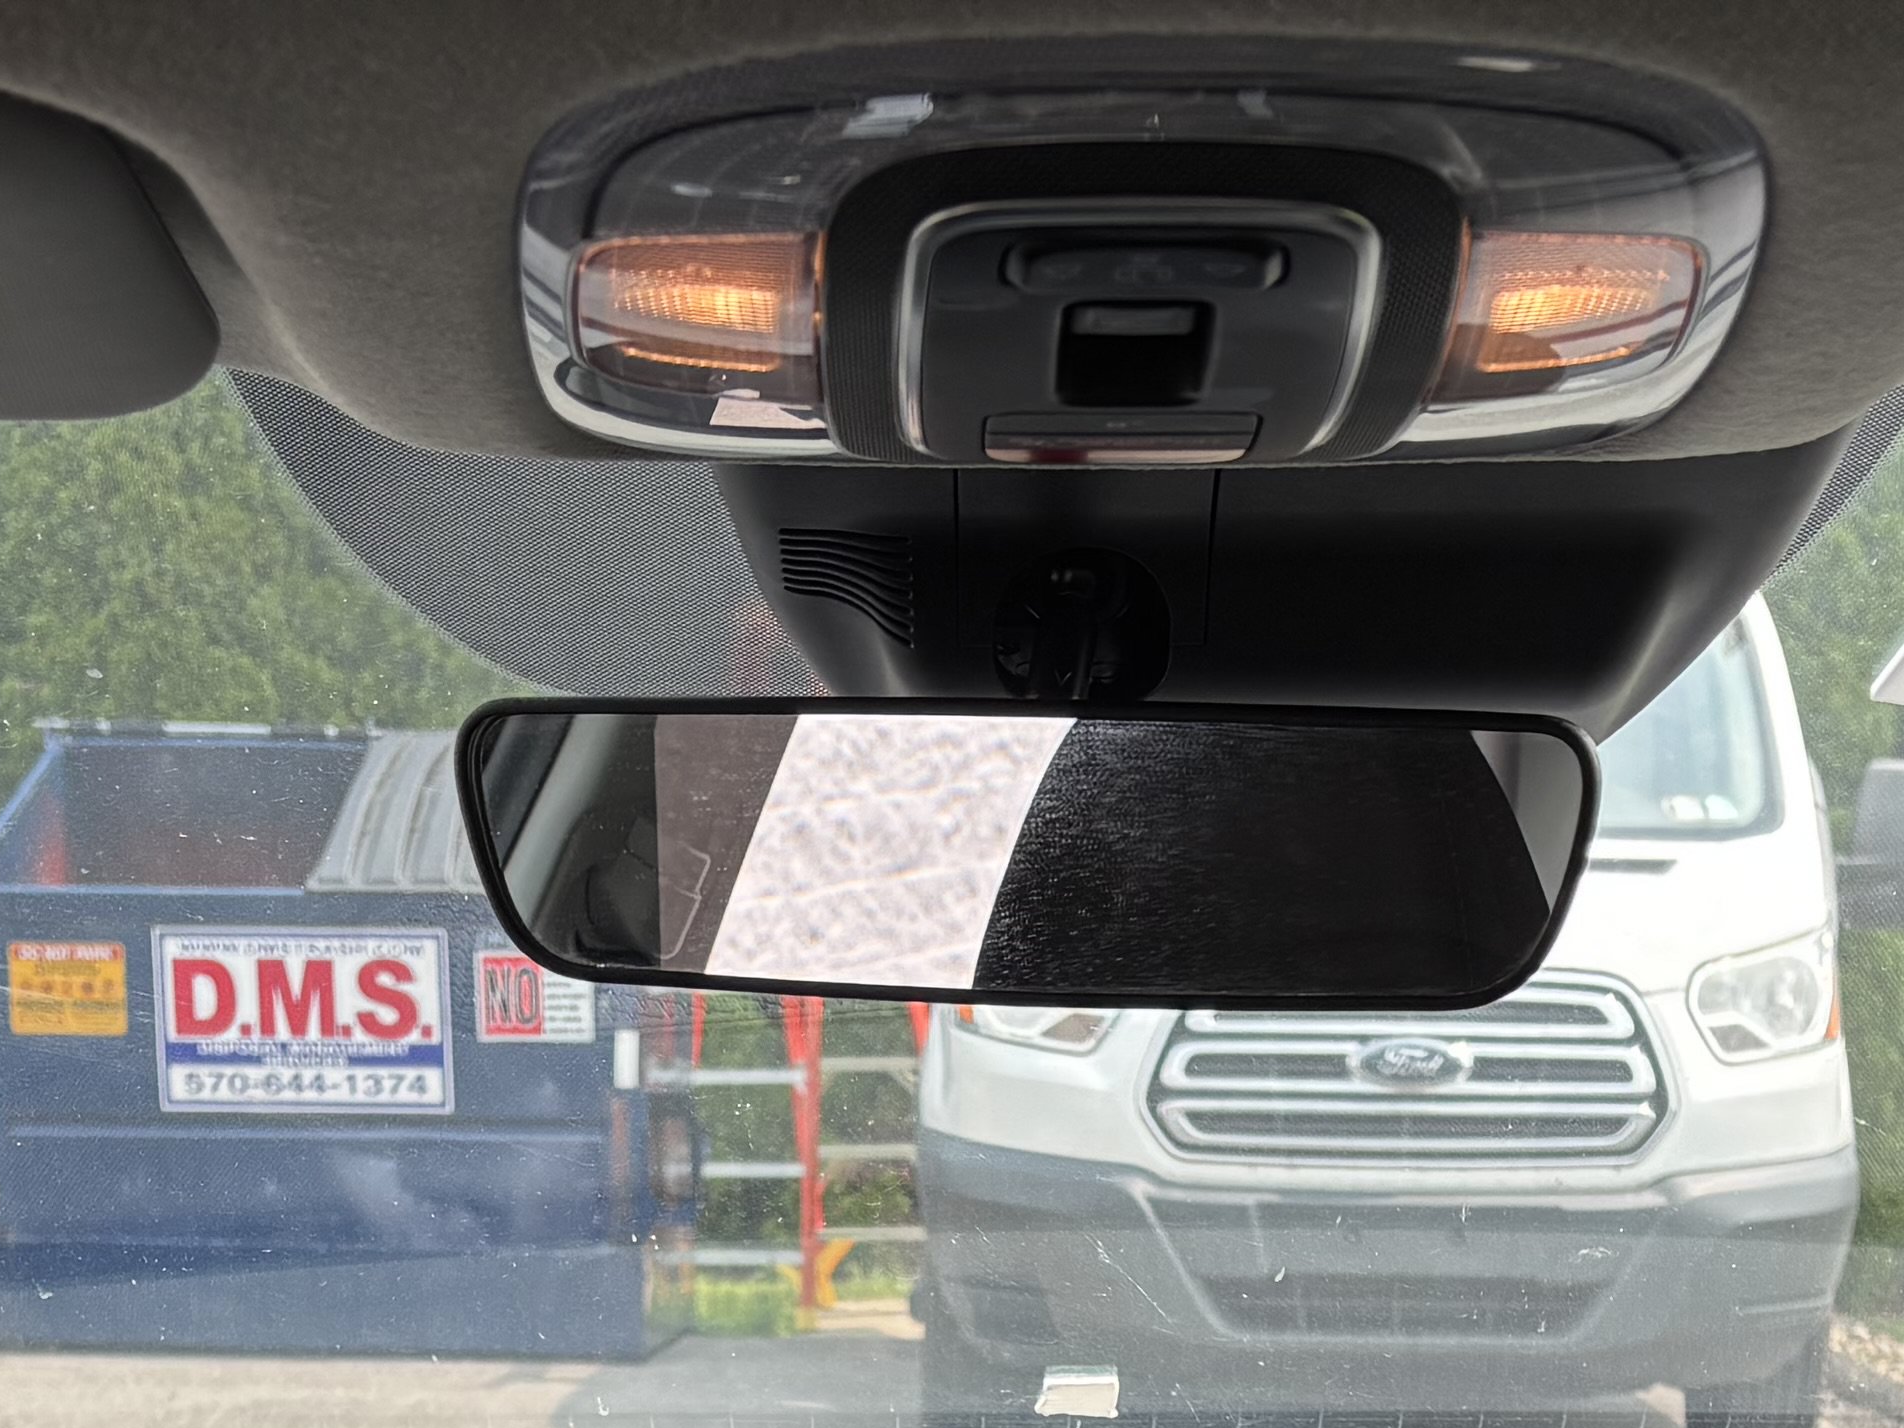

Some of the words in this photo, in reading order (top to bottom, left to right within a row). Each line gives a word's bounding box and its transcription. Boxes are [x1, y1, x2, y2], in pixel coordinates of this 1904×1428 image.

[172, 958, 433, 1041] D.M.S.
[484, 964, 540, 1025] NO
[184, 1071, 430, 1099] 570-644-1374
